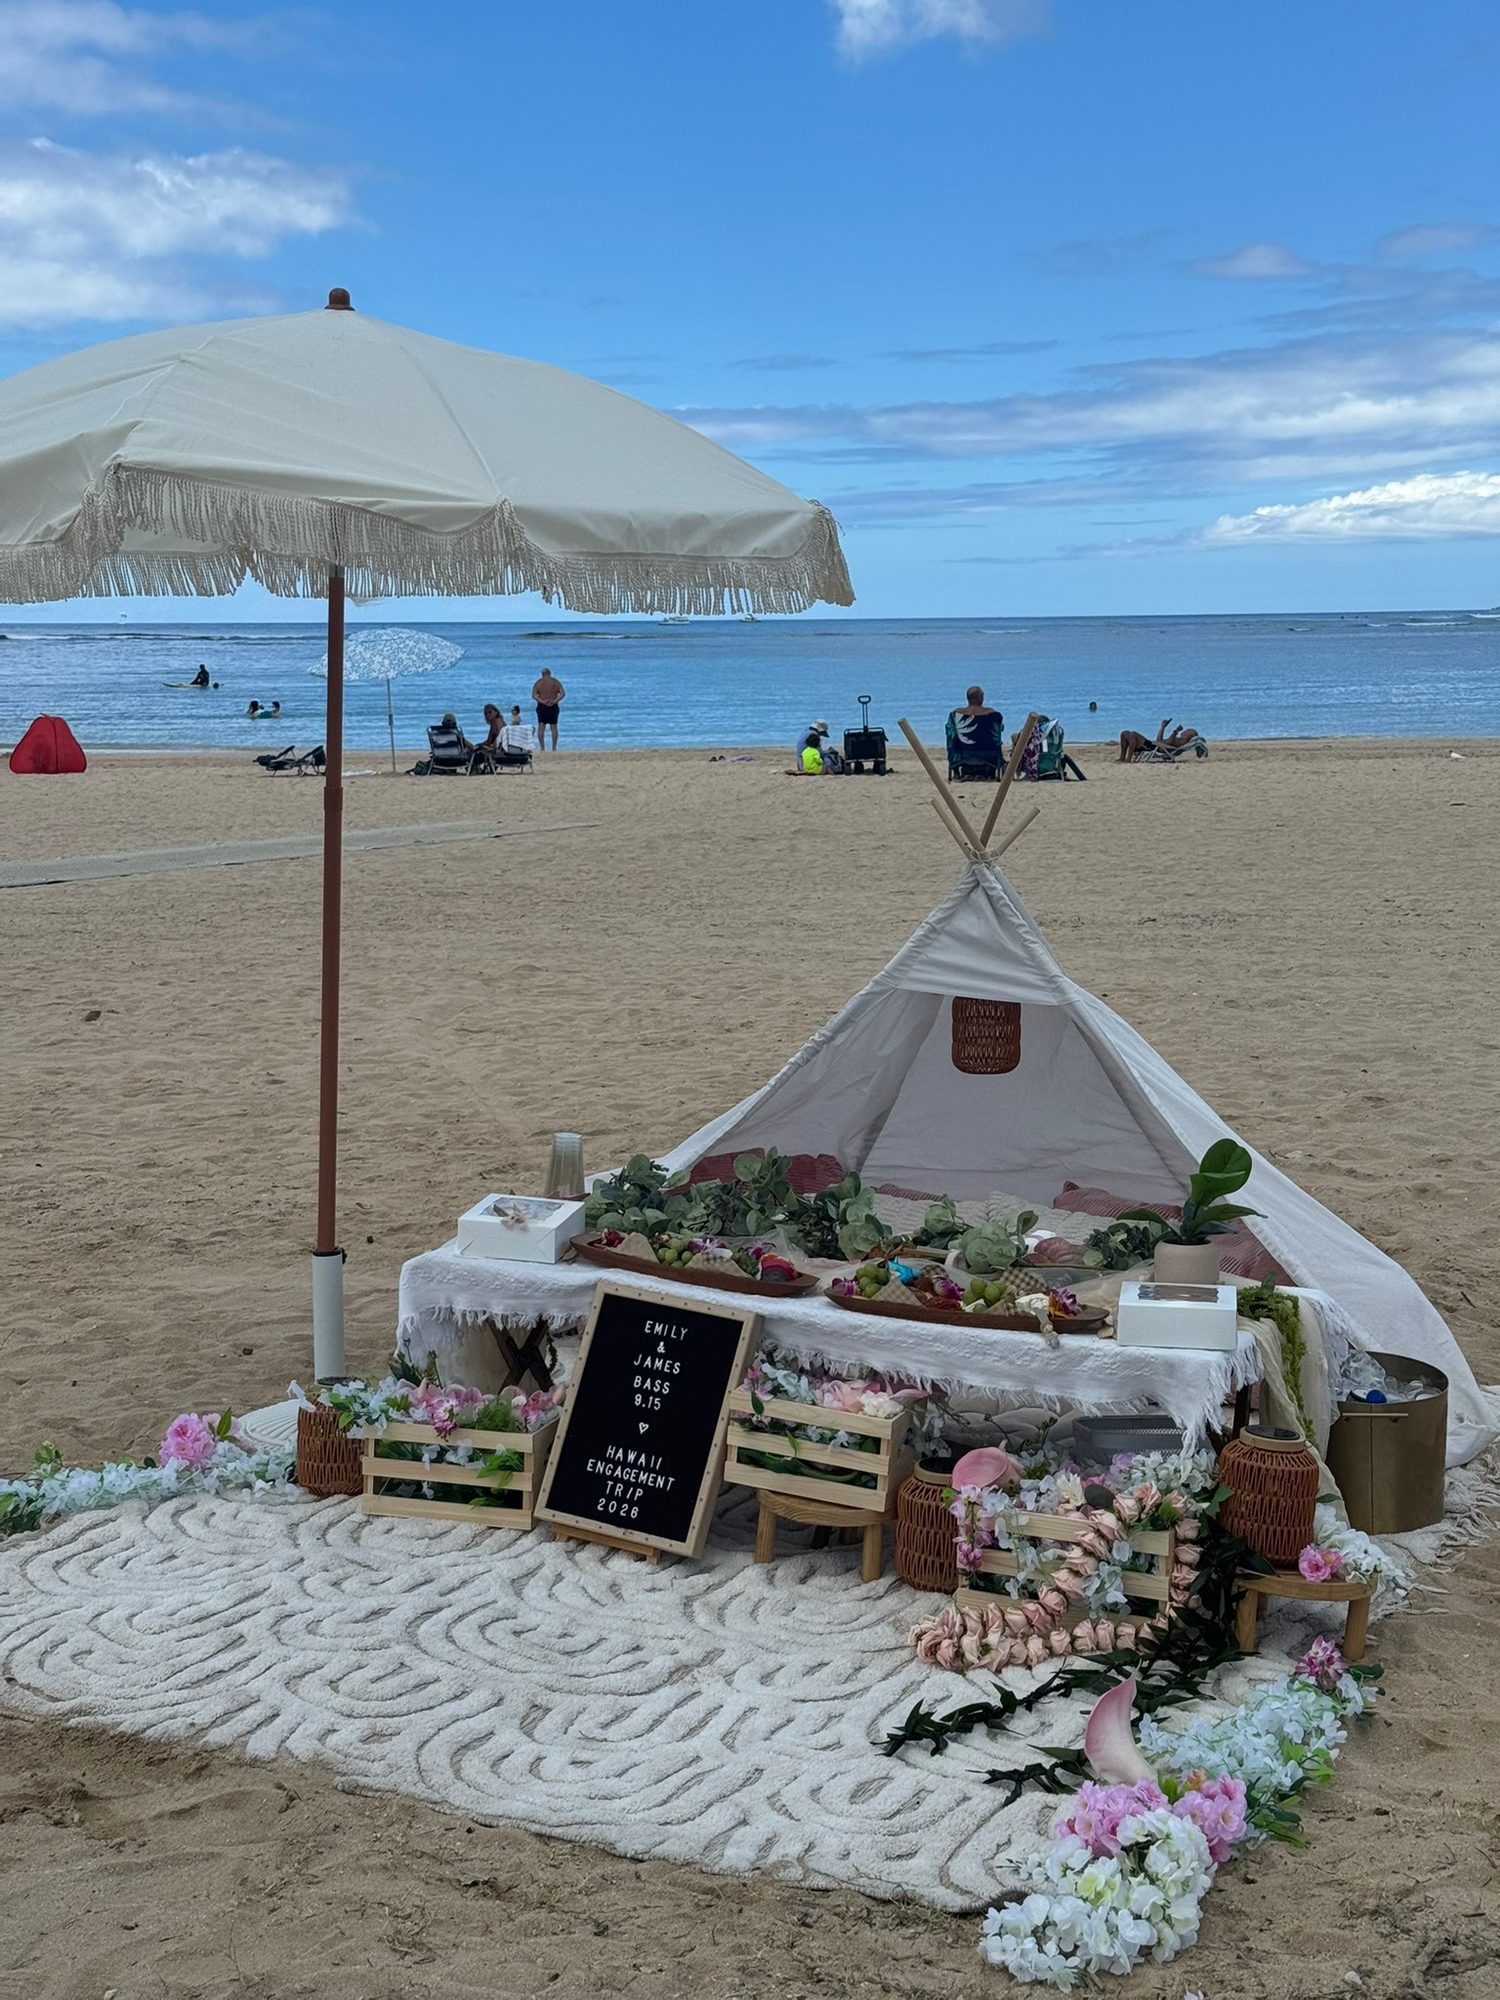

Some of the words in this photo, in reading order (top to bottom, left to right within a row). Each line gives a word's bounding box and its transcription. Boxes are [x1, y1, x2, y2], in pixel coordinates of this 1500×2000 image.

[644, 1320, 688, 1341] EMILY
[656, 1341, 666, 1354] &
[633, 1353, 681, 1375] JAMES
[633, 1375, 671, 1395] BASS
[634, 1393, 661, 1411] 9.15
[606, 1445, 663, 1470] HAWAII
[586, 1458, 675, 1491] ENGAGEMENT
[606, 1480, 644, 1501] TRIP
[597, 1497, 639, 1519] 2026
